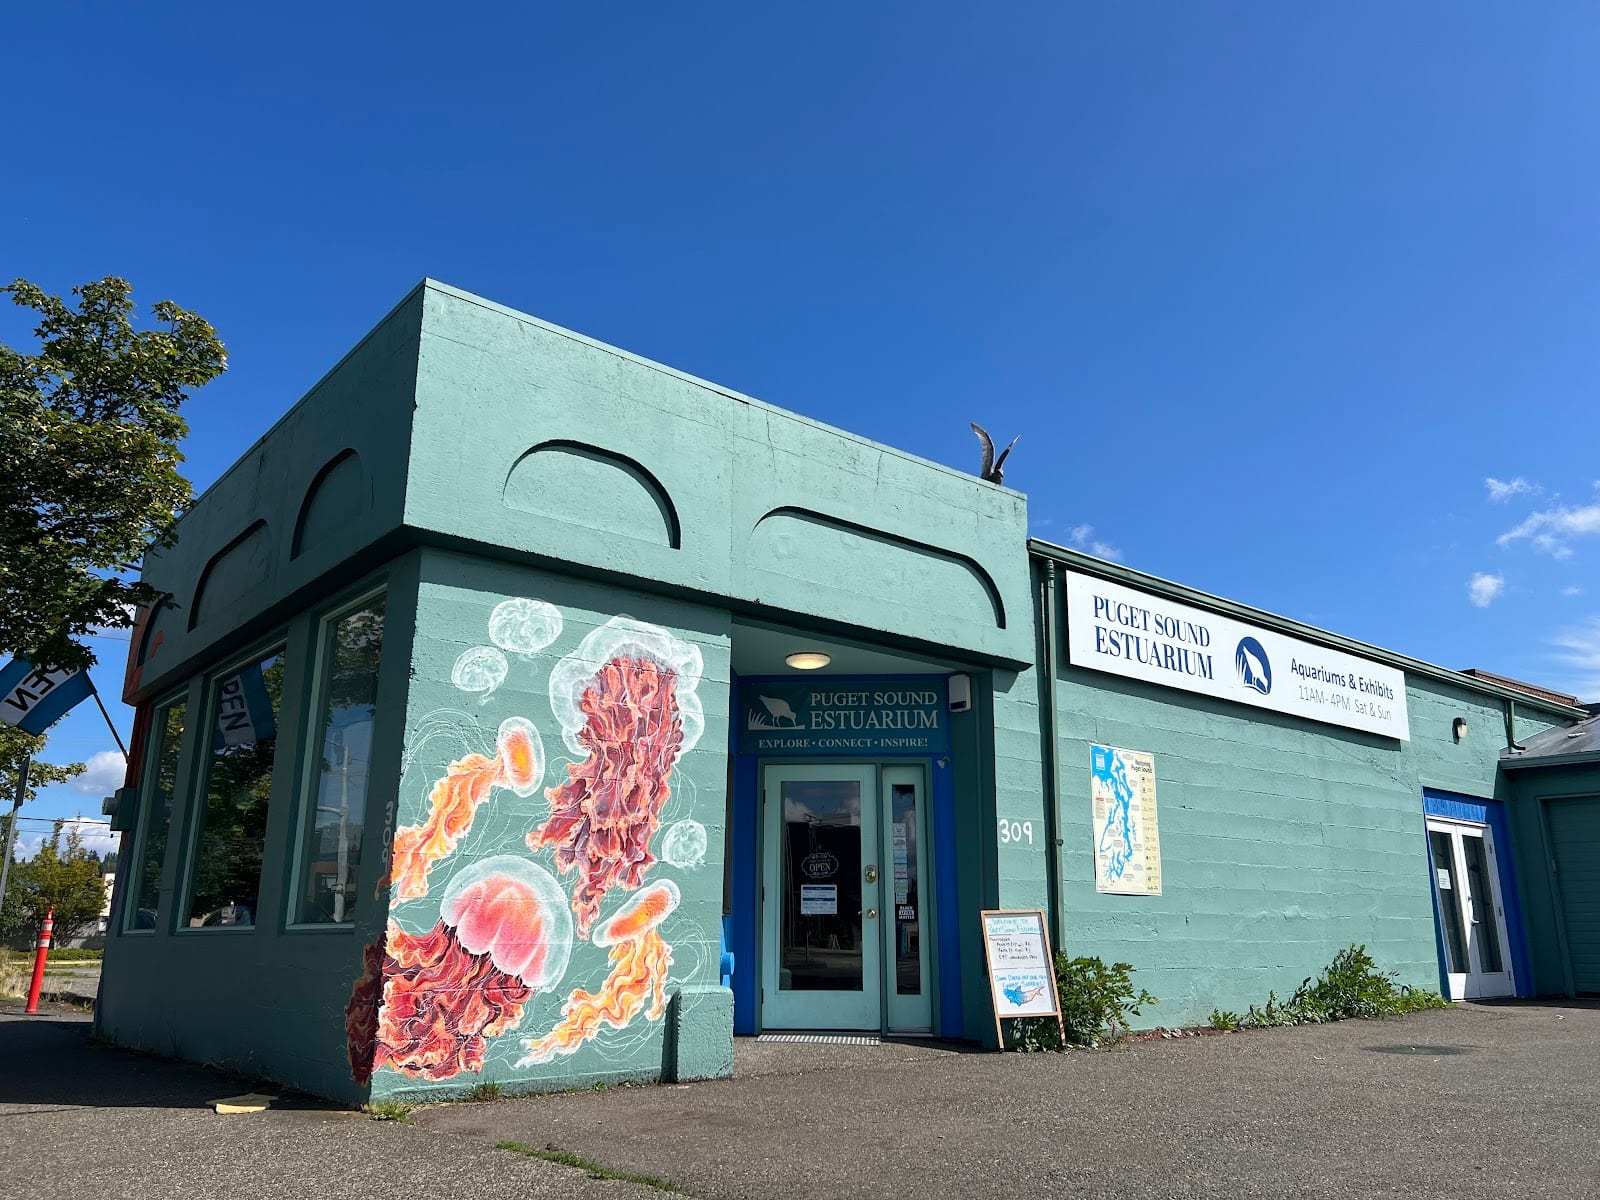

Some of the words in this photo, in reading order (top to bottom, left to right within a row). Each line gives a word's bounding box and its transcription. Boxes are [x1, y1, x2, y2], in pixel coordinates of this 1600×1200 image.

[1093, 595, 1150, 631] PUGET
[1154, 613, 1210, 647] SOUND
[1094, 625, 1214, 680] ESTUARIUM
[1291, 657, 1346, 687] Aquariums
[1348, 673, 1357, 690] &
[1359, 676, 1394, 700] Exhibits
[810, 692, 869, 706] PUGET
[873, 691, 938, 705] SOUND
[1355, 699, 1367, 715] Sat
[1370, 702, 1377, 717] &
[1378, 705, 1392, 720] Sun
[810, 709, 939, 730] ESTUARIUM
[758, 739, 811, 748] EXPLORE
[818, 738, 872, 748] CONNECT
[880, 738, 928, 747] INSPIRE!
[382, 800, 394, 873] 309
[999, 818, 1032, 845] 309
[809, 862, 831, 872] OPEN
